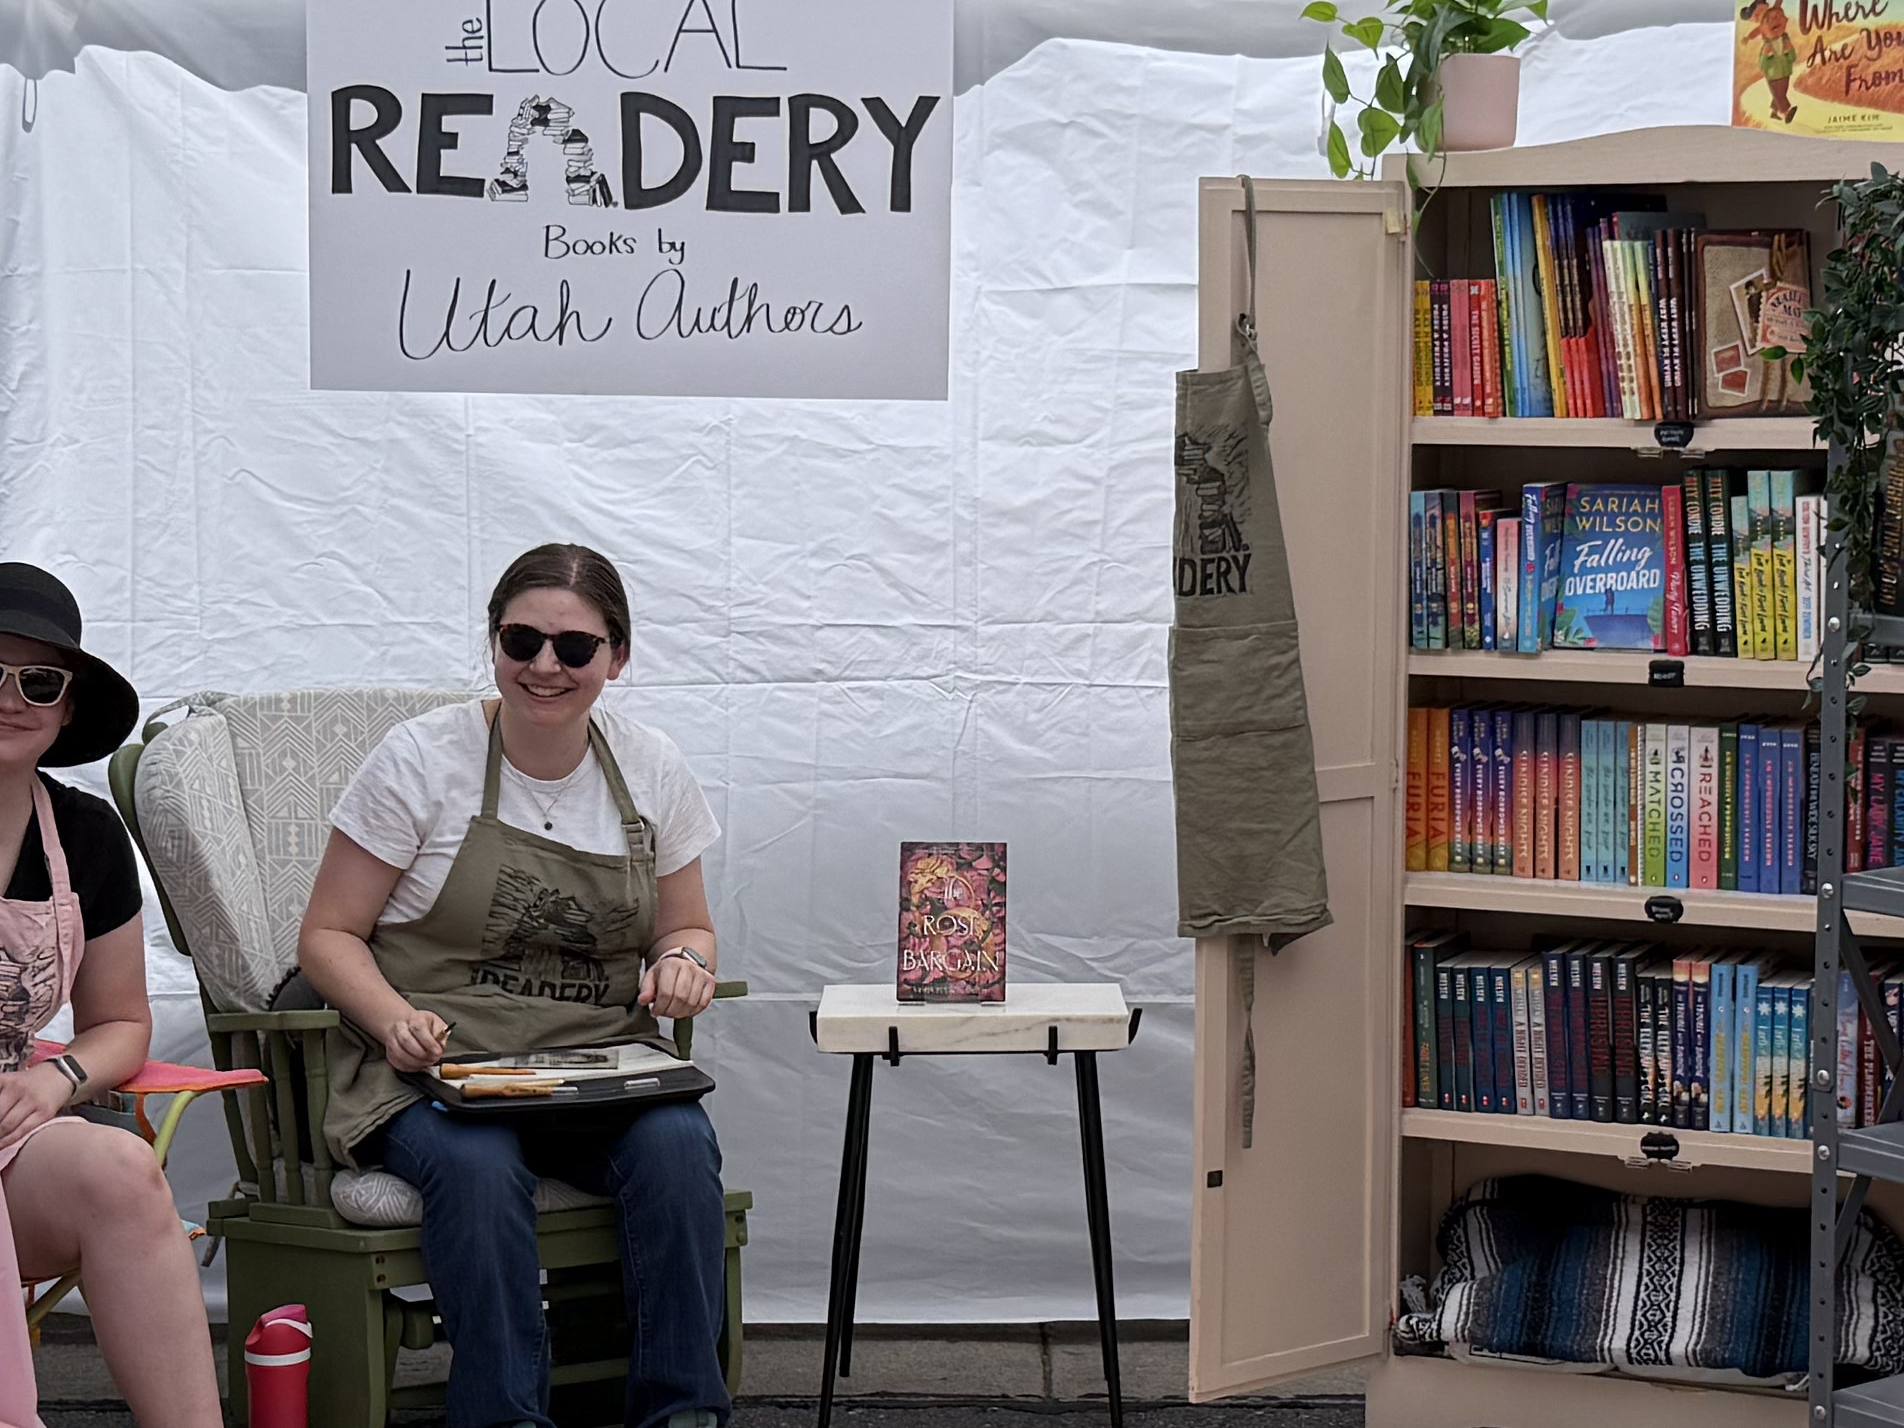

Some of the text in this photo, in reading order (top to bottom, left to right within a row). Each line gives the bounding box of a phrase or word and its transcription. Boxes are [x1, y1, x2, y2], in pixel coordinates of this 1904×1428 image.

[444, 17, 484, 68] the
[1806, 35, 1854, 69] Are
[544, 225, 686, 266] Books by
[398, 268, 863, 361] Utah Authors
[1575, 515, 1661, 533] WILSON
[1578, 496, 1662, 514] SARIAH
[1573, 534, 1653, 573] Falling
[1564, 568, 1661, 597] OVERBOARD
[1406, 771, 1422, 840] FURIA
[1430, 771, 1445, 840] FURIA
[1649, 771, 1661, 858] MATCHED
[1698, 772, 1713, 862] REACHED
[1870, 773, 1886, 864] MY LADY JANE
[902, 948, 999, 972] BARGAIN
